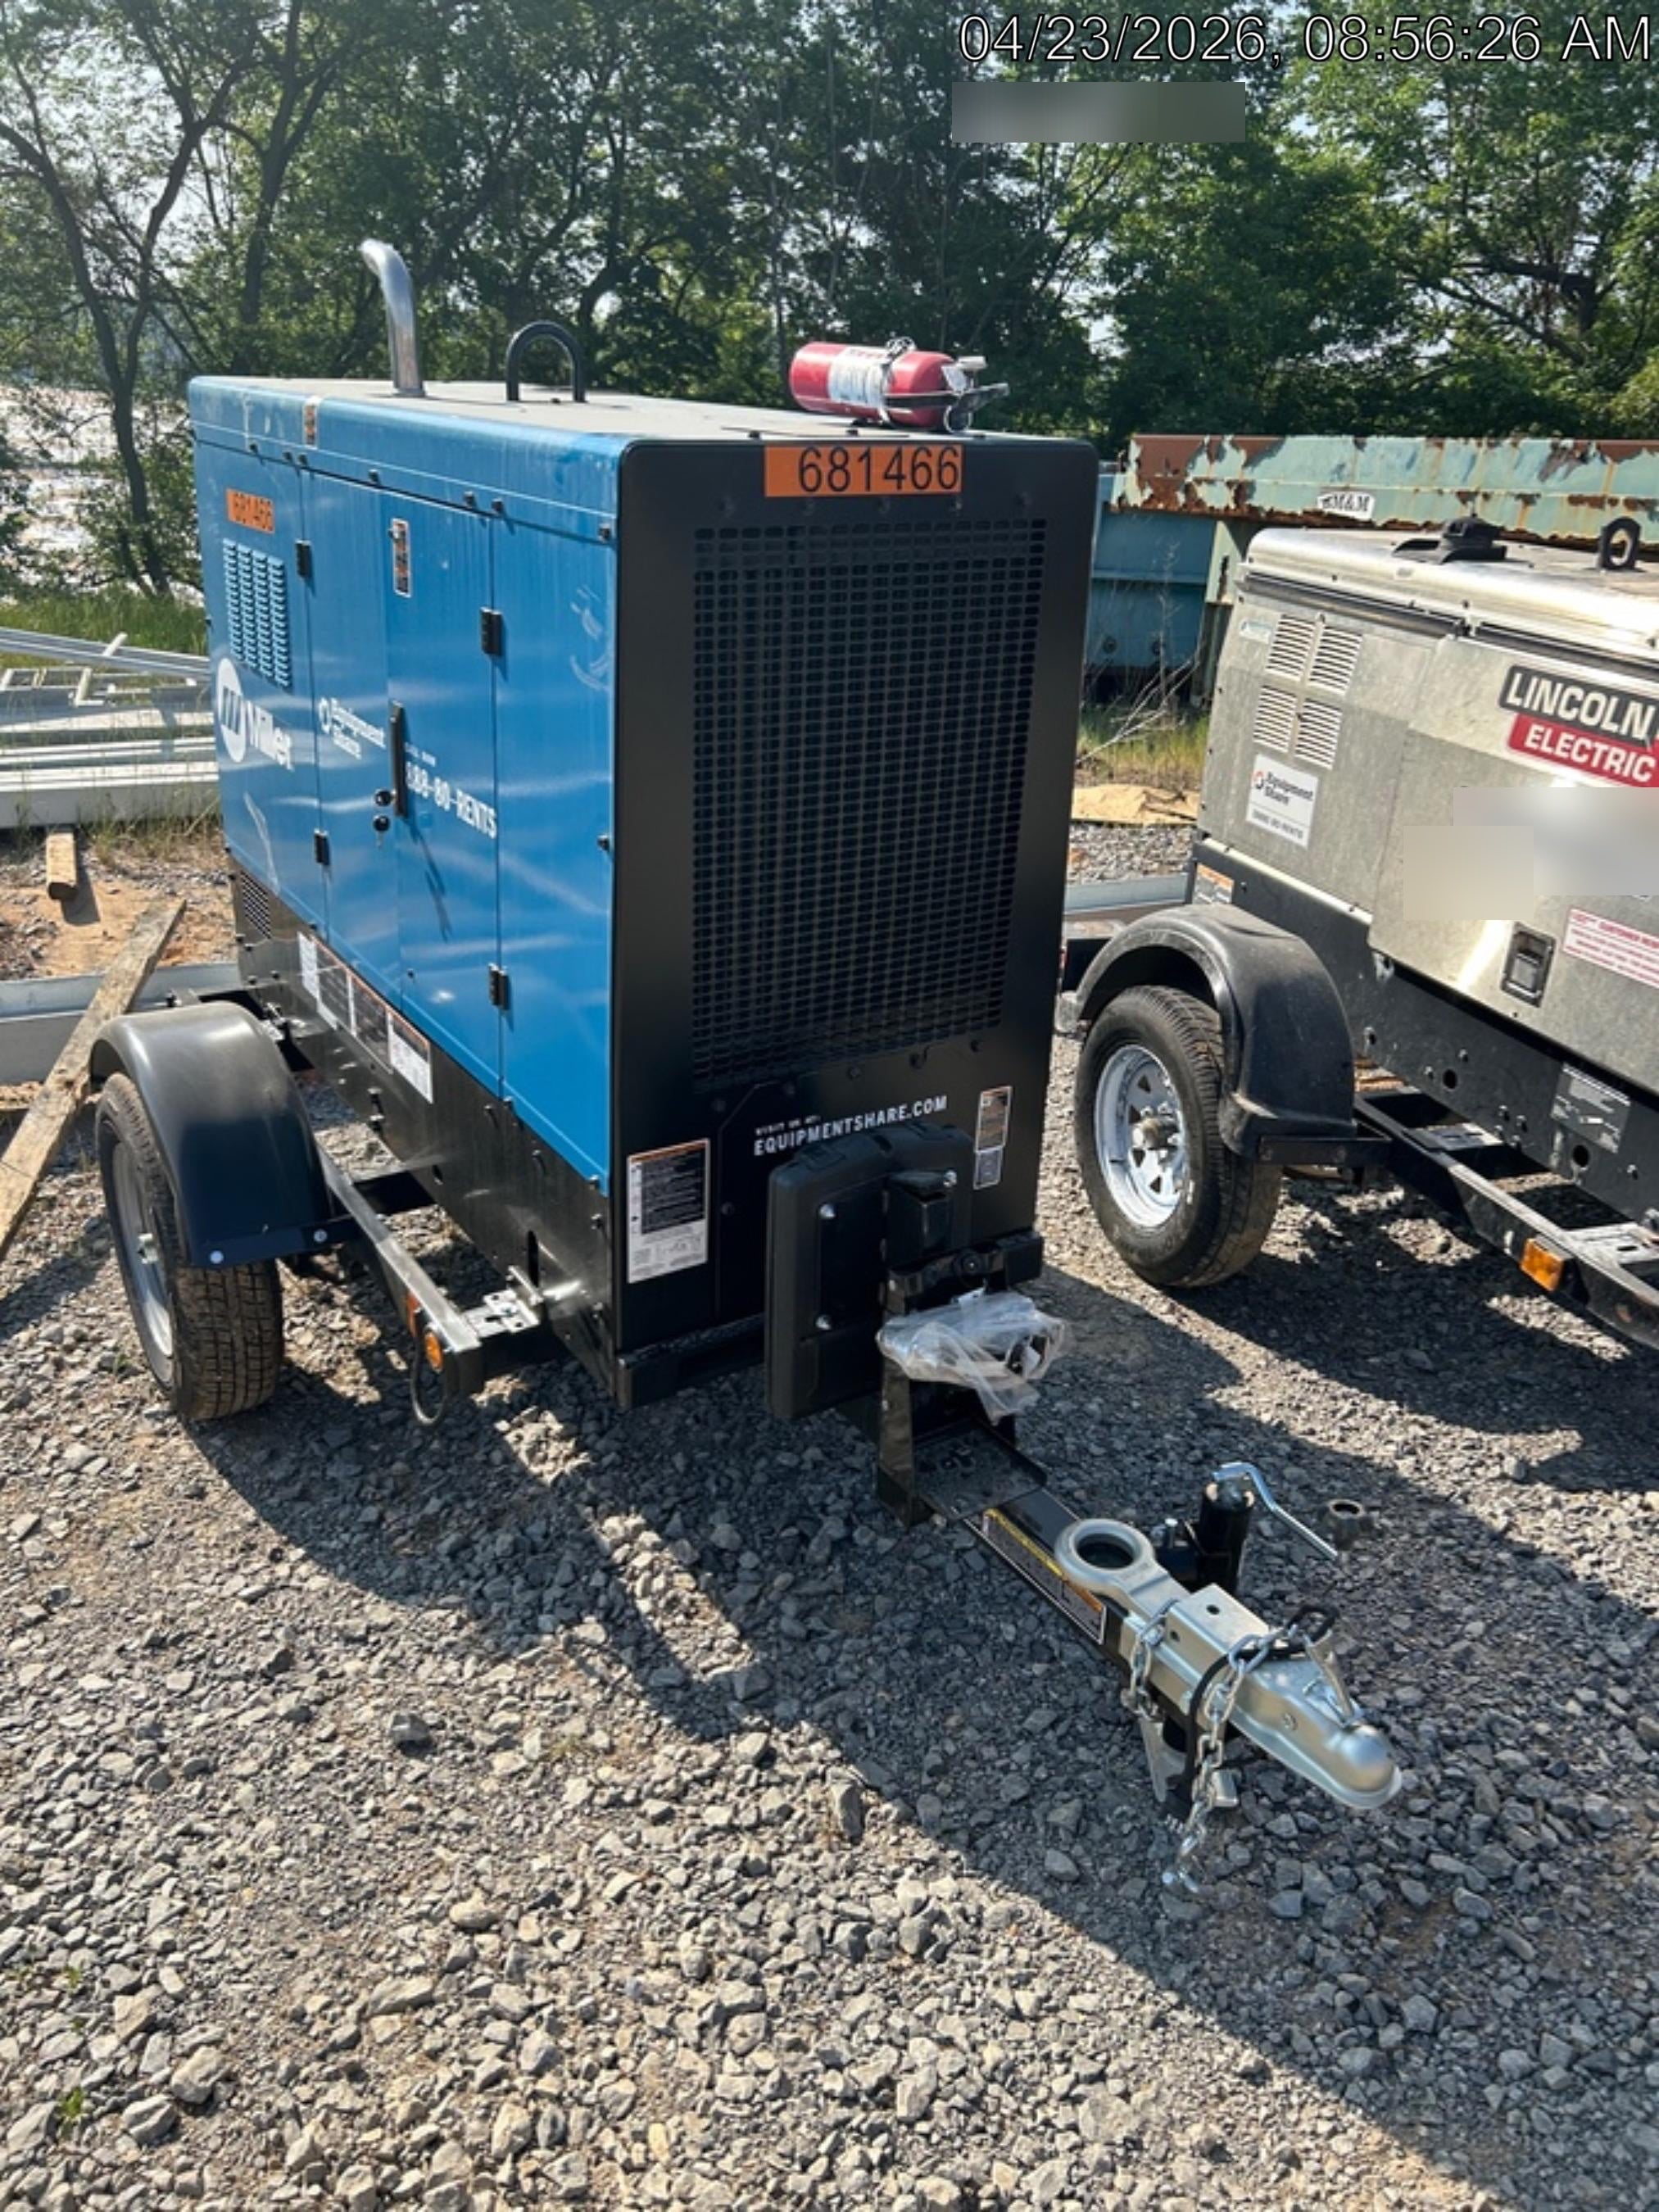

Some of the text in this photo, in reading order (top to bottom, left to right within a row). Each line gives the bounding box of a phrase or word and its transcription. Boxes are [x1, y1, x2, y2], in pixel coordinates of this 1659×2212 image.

[798, 446, 961, 493] 681466
[1506, 673, 1656, 741] LINCOLN
[1524, 723, 1657, 783] ELECTRIC
[754, 1095, 948, 1156] EQUIPMENTSHARE.COM
